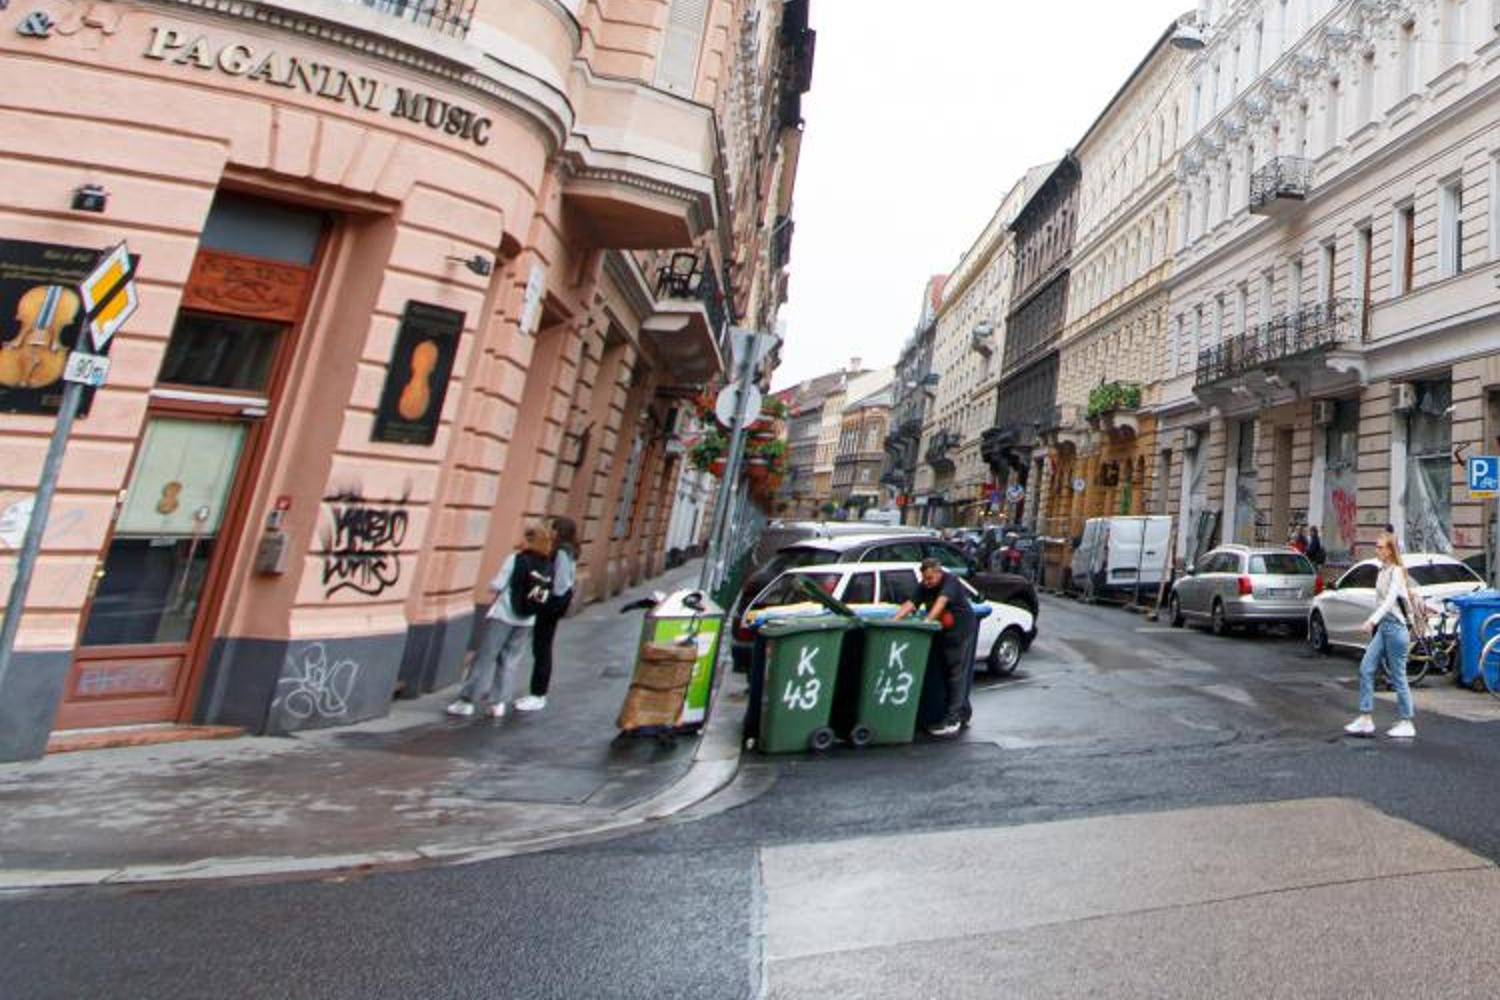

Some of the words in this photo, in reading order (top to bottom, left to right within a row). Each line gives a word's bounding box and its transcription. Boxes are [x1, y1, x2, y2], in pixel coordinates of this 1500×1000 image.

[142, 23, 383, 112] PAGANINI
[390, 86, 494, 147] MUSIC
[1472, 459, 1489, 487] P
[797, 647, 820, 676] K
[888, 641, 910, 669] K
[783, 679, 821, 711] 43
